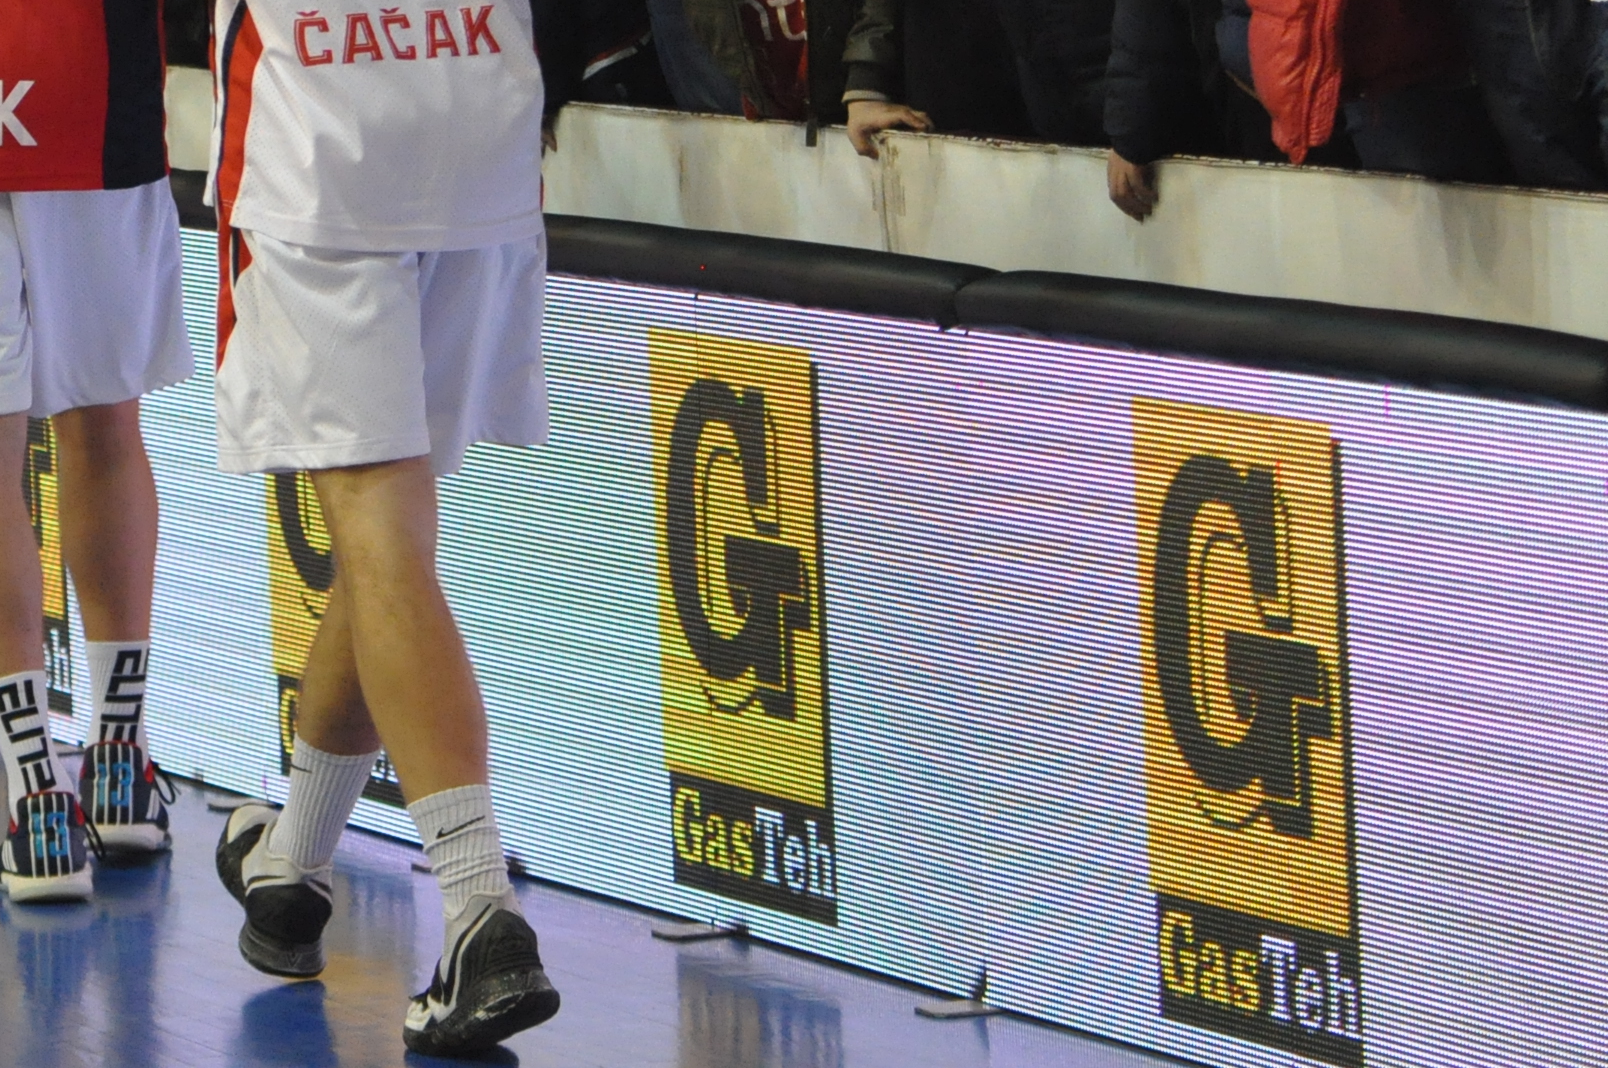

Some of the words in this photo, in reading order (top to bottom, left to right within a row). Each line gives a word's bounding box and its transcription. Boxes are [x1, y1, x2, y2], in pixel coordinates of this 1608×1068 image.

[293, 4, 501, 68] ČAČAK
[672, 786, 836, 899] GasTeh
[1158, 909, 1360, 1033] GasTeh
